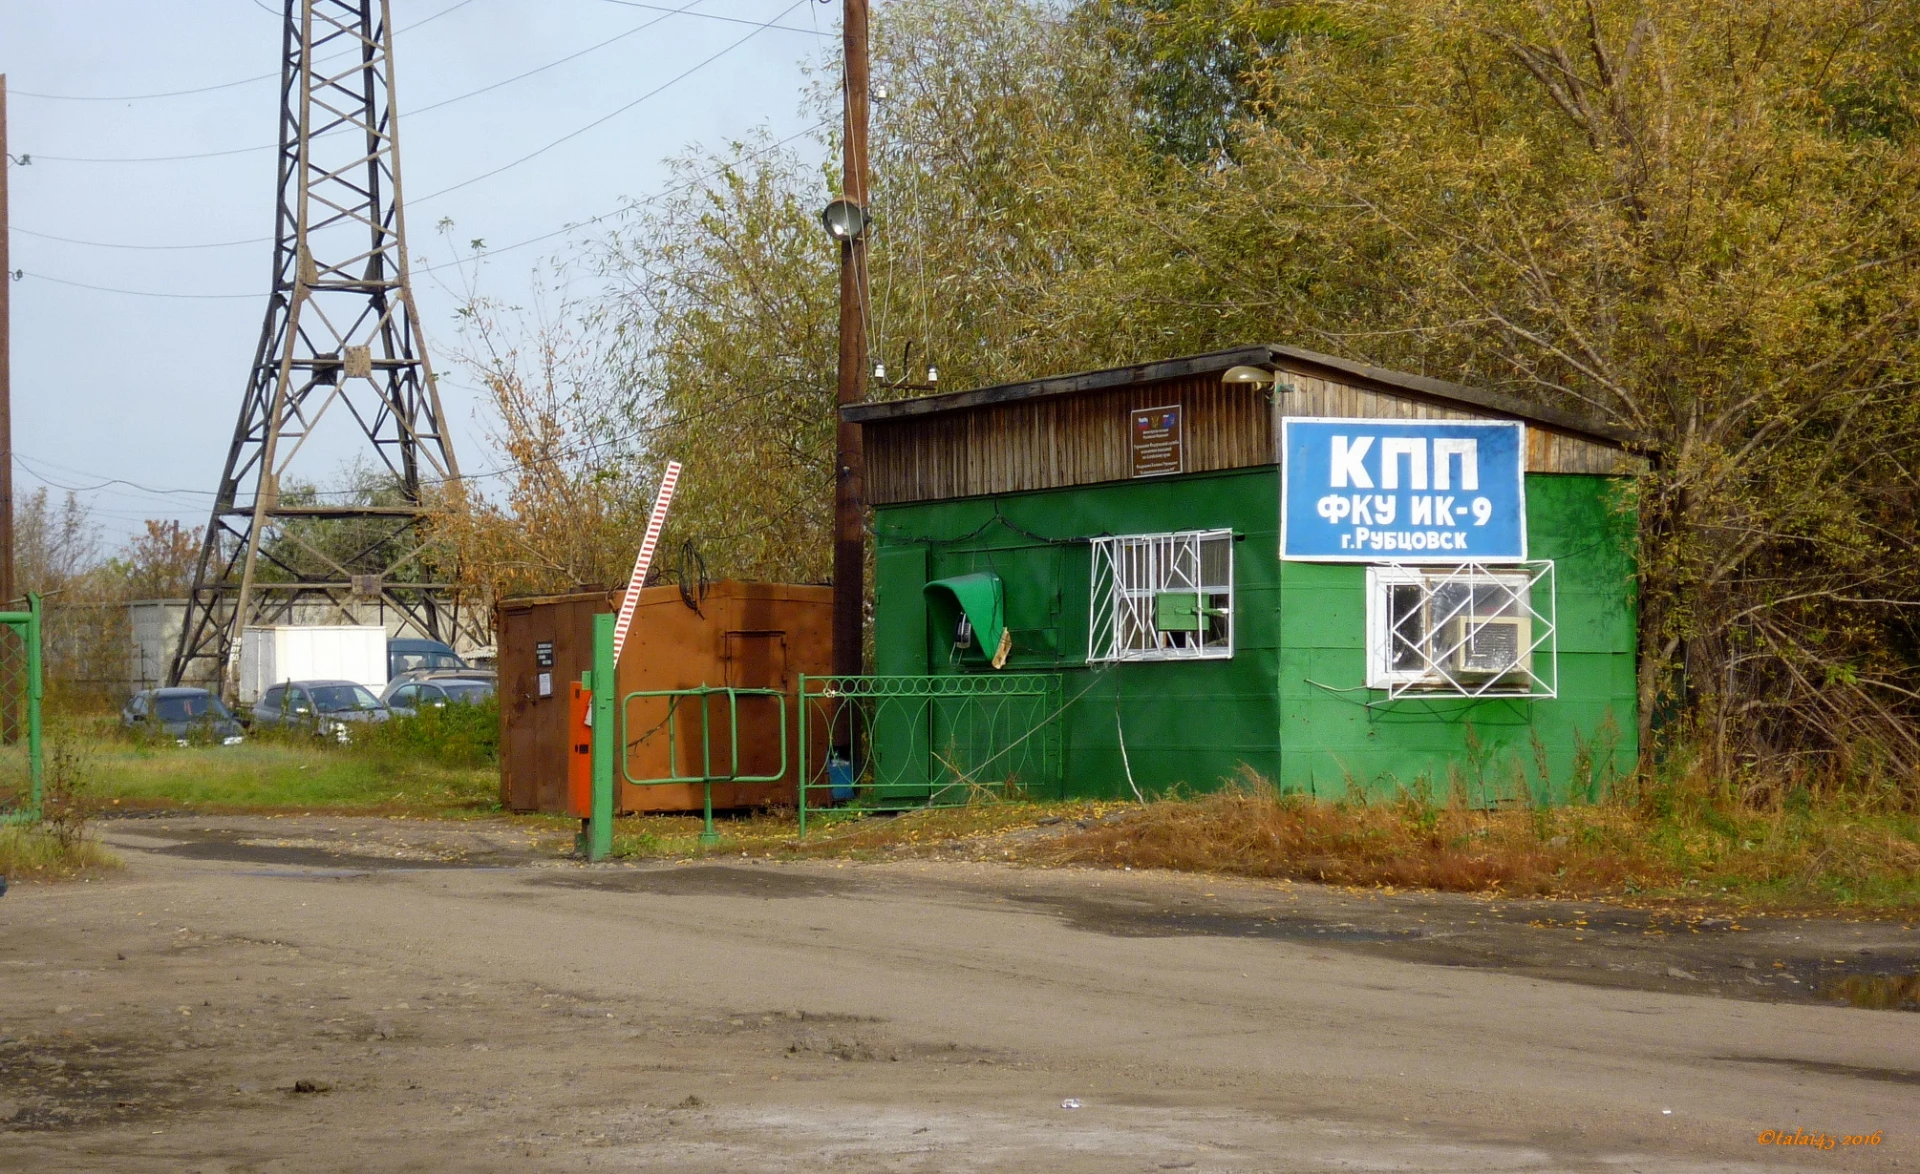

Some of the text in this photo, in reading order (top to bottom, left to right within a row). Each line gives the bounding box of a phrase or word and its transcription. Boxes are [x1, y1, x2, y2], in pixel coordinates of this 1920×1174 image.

[1330, 435, 1479, 490] КПП
[1317, 494, 1492, 526] ФКУ ИК-9
